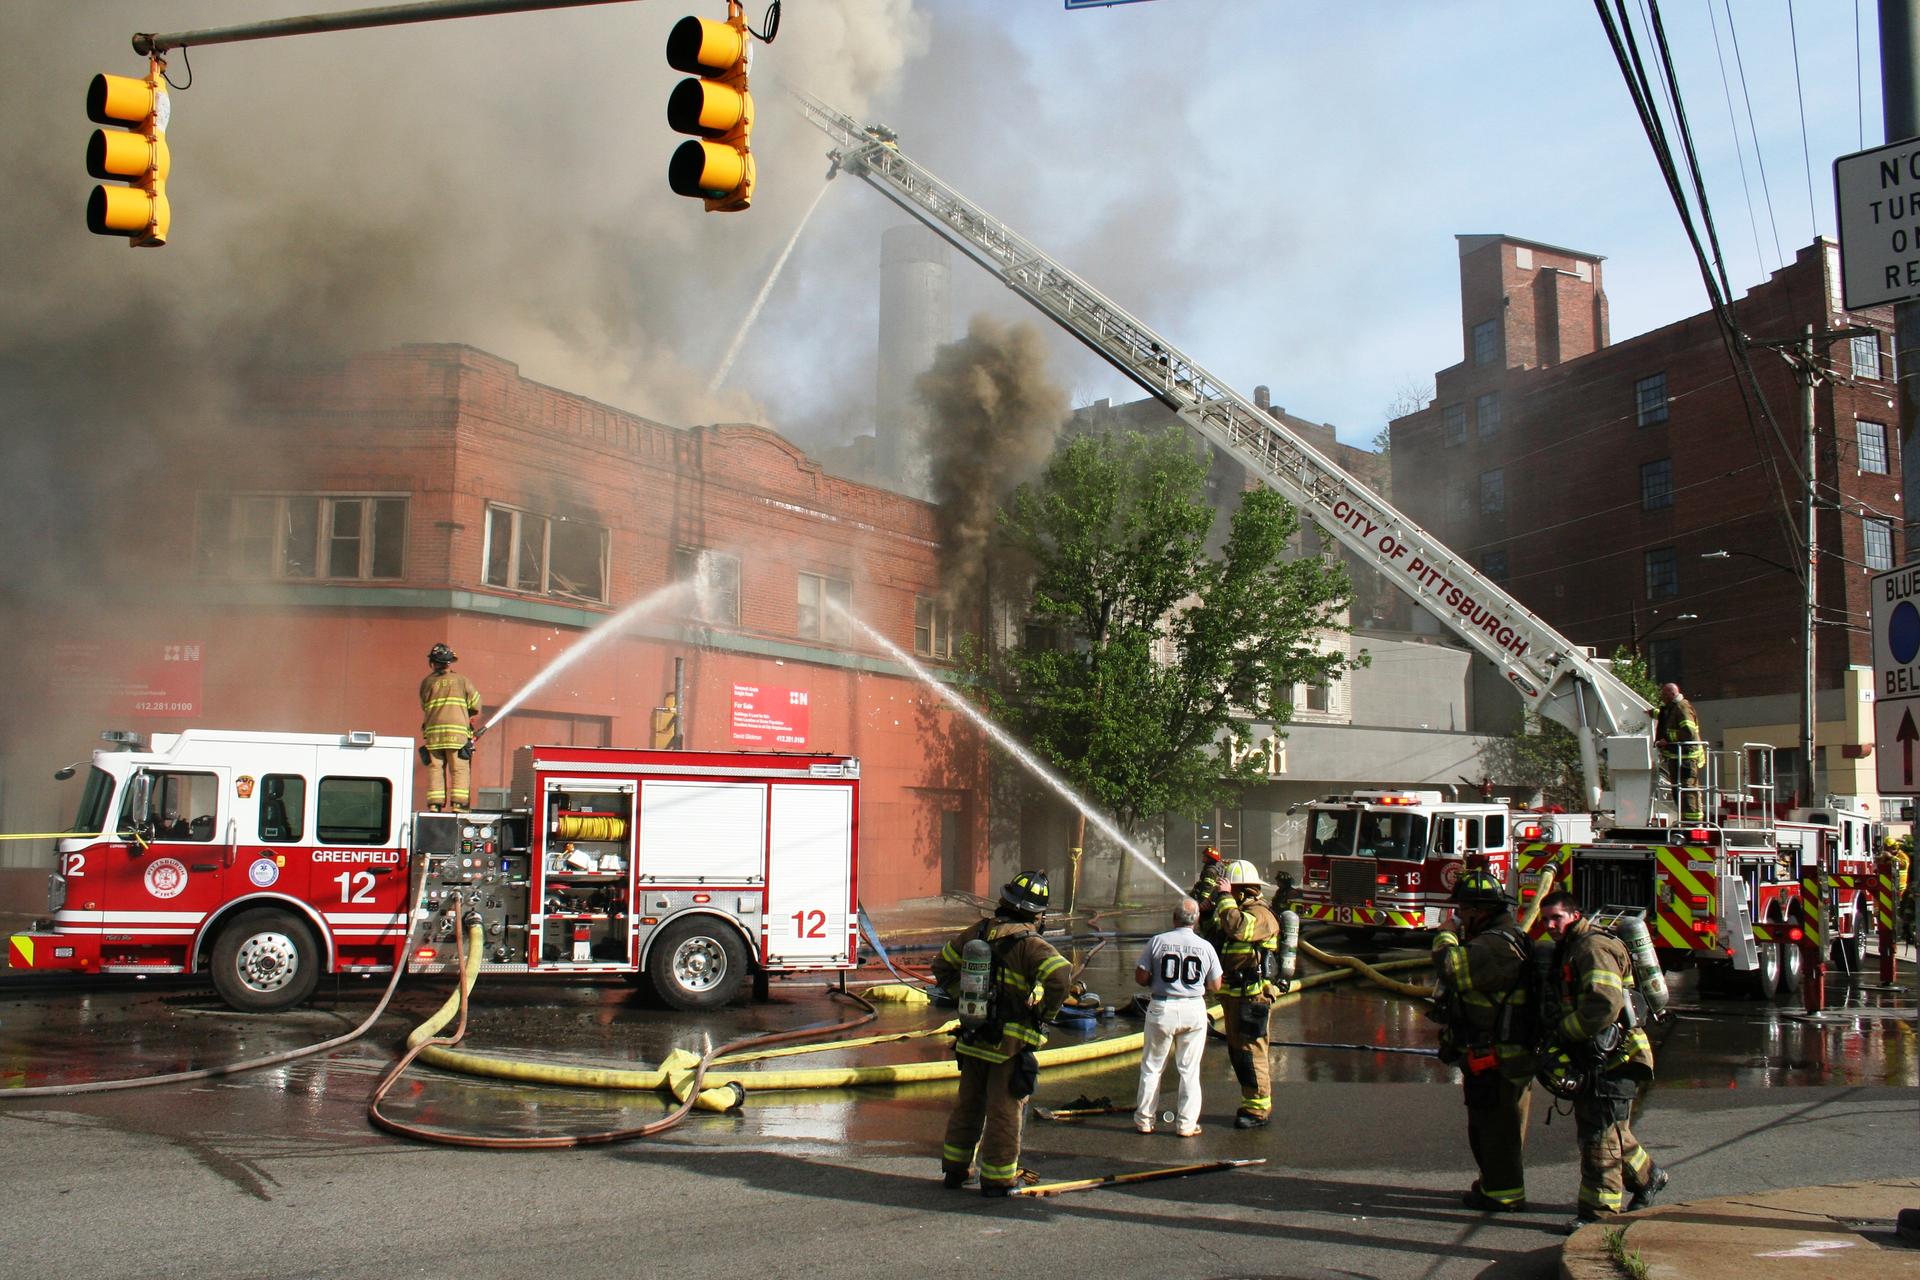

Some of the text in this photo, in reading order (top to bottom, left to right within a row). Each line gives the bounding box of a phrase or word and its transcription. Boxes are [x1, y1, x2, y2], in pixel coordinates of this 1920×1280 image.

[1333, 501, 1530, 658] CITY OF PITTSBURGH
[1886, 571, 1920, 602] BLUE
[1886, 665, 1920, 694] BEL
[135, 702, 193, 711] 412.281.0100
[743, 702, 753, 710] Sale
[60, 853, 86, 877] 12
[147, 859, 185, 876] PITTSBURGH
[311, 850, 400, 864] GREENFIELD
[1404, 871, 1421, 885] 13
[1489, 862, 1500, 880] 13
[333, 871, 376, 904] 12
[791, 909, 827, 939] 12
[1334, 906, 1352, 923] 13
[1161, 953, 1202, 985] 00
